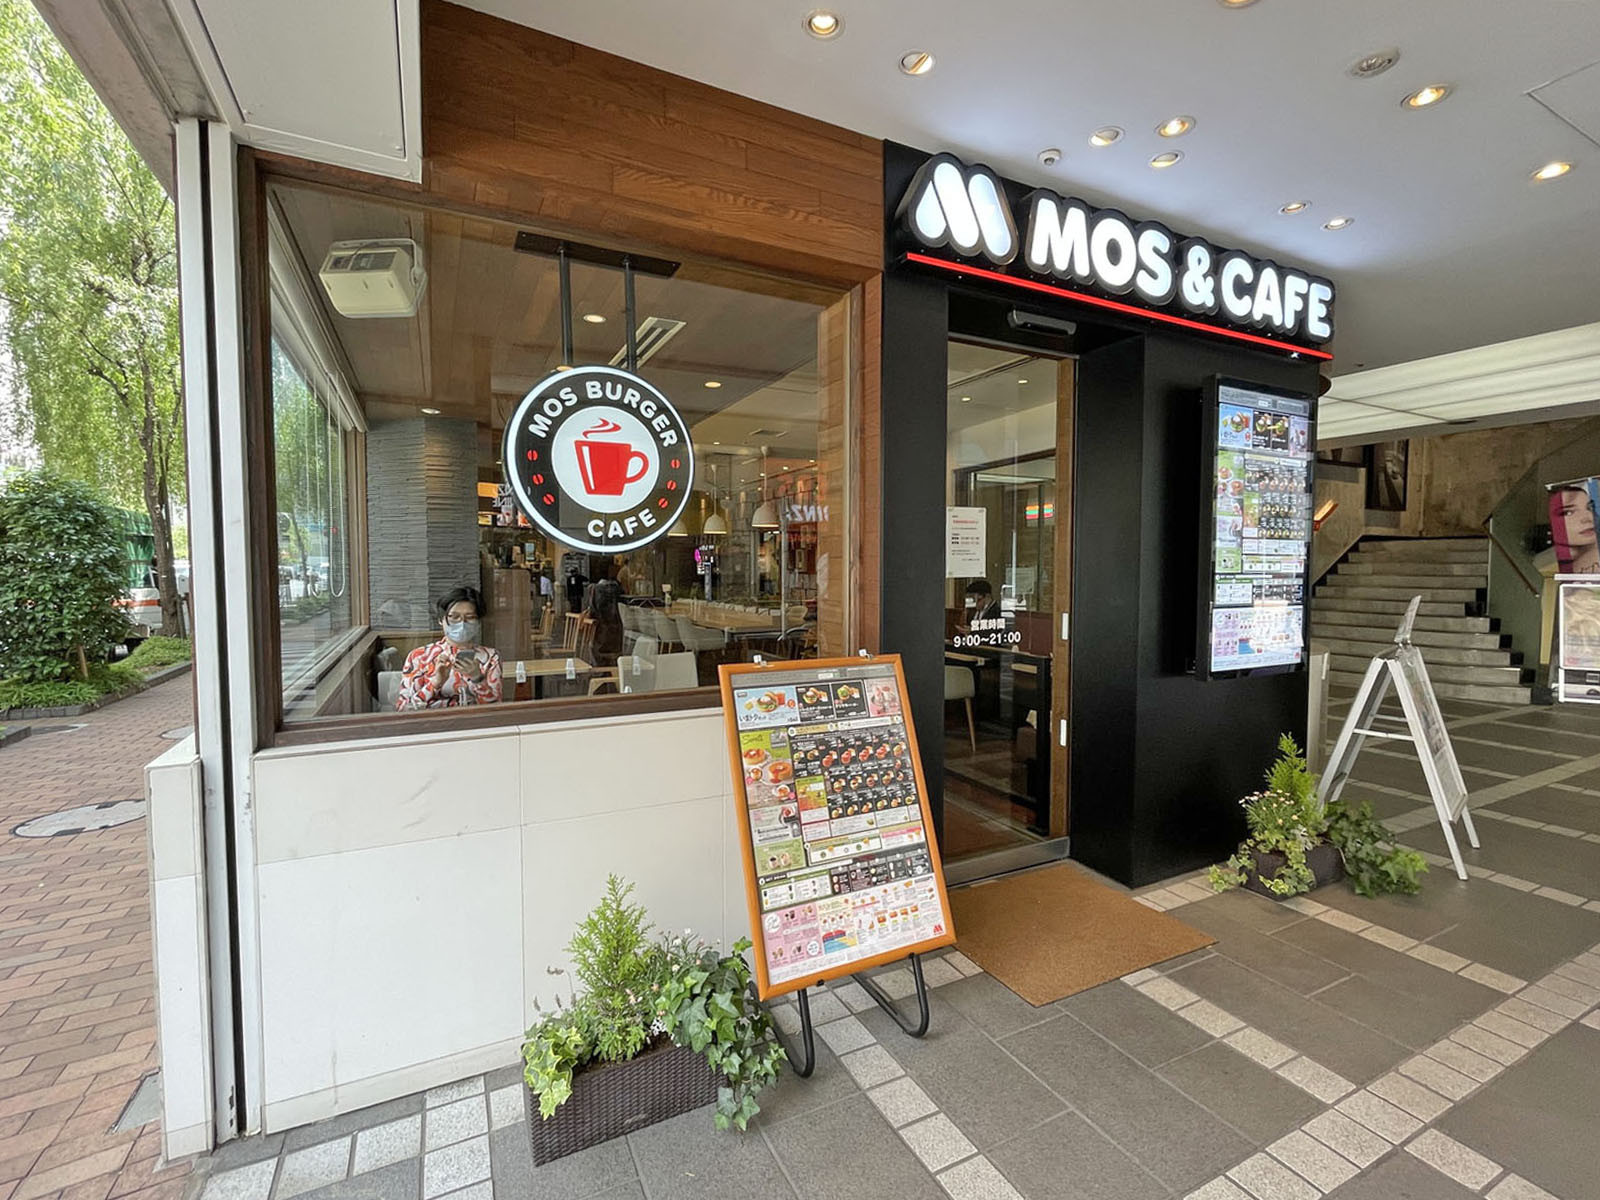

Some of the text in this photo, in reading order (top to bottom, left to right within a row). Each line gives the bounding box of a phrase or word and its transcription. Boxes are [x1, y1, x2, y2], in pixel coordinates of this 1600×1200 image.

[1032, 197, 1173, 298] MOS
[1181, 244, 1215, 307] &
[1221, 256, 1333, 338] CAFE
[528, 380, 679, 447] MOS BURGER
[587, 508, 657, 539] CAFE
